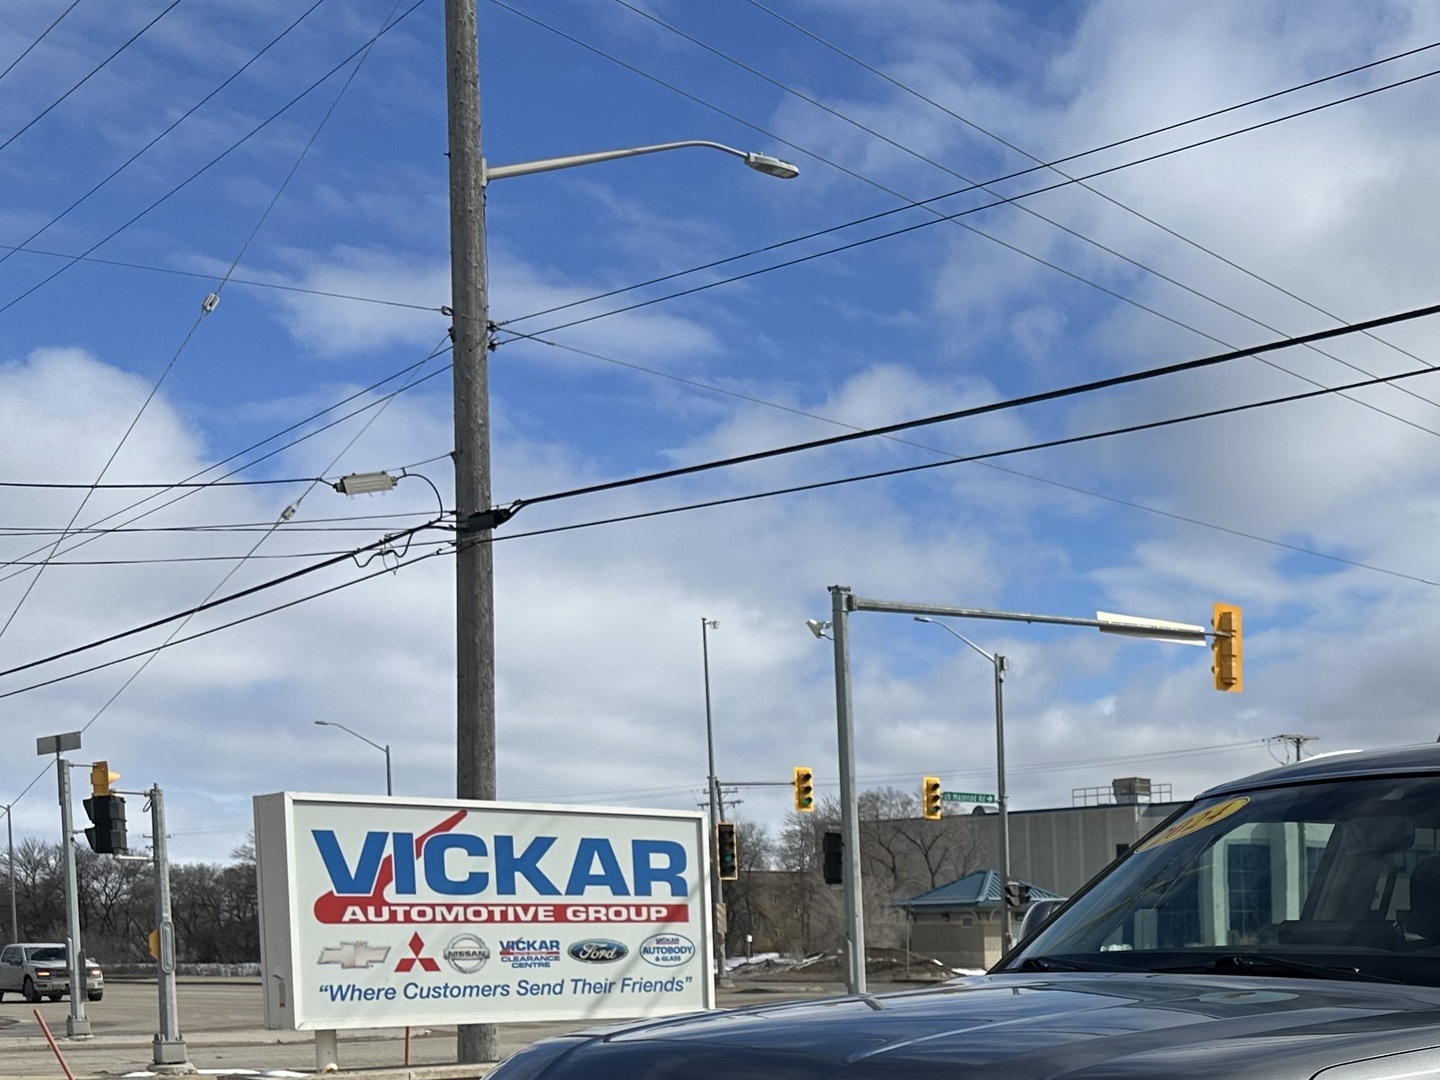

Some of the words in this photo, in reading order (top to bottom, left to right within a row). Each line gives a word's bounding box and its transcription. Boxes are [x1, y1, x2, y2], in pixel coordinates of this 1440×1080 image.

[311, 829, 689, 897] VICKAR
[342, 905, 554, 922] AUTOMOTIVE
[566, 906, 668, 922] GROUP
[499, 940, 560, 951] VICKAR
[579, 943, 617, 959] Ford
[643, 946, 692, 954] AUTOBODY
[403, 982, 510, 1000] Customers
[516, 979, 565, 996] Send
[570, 978, 616, 995] Their
